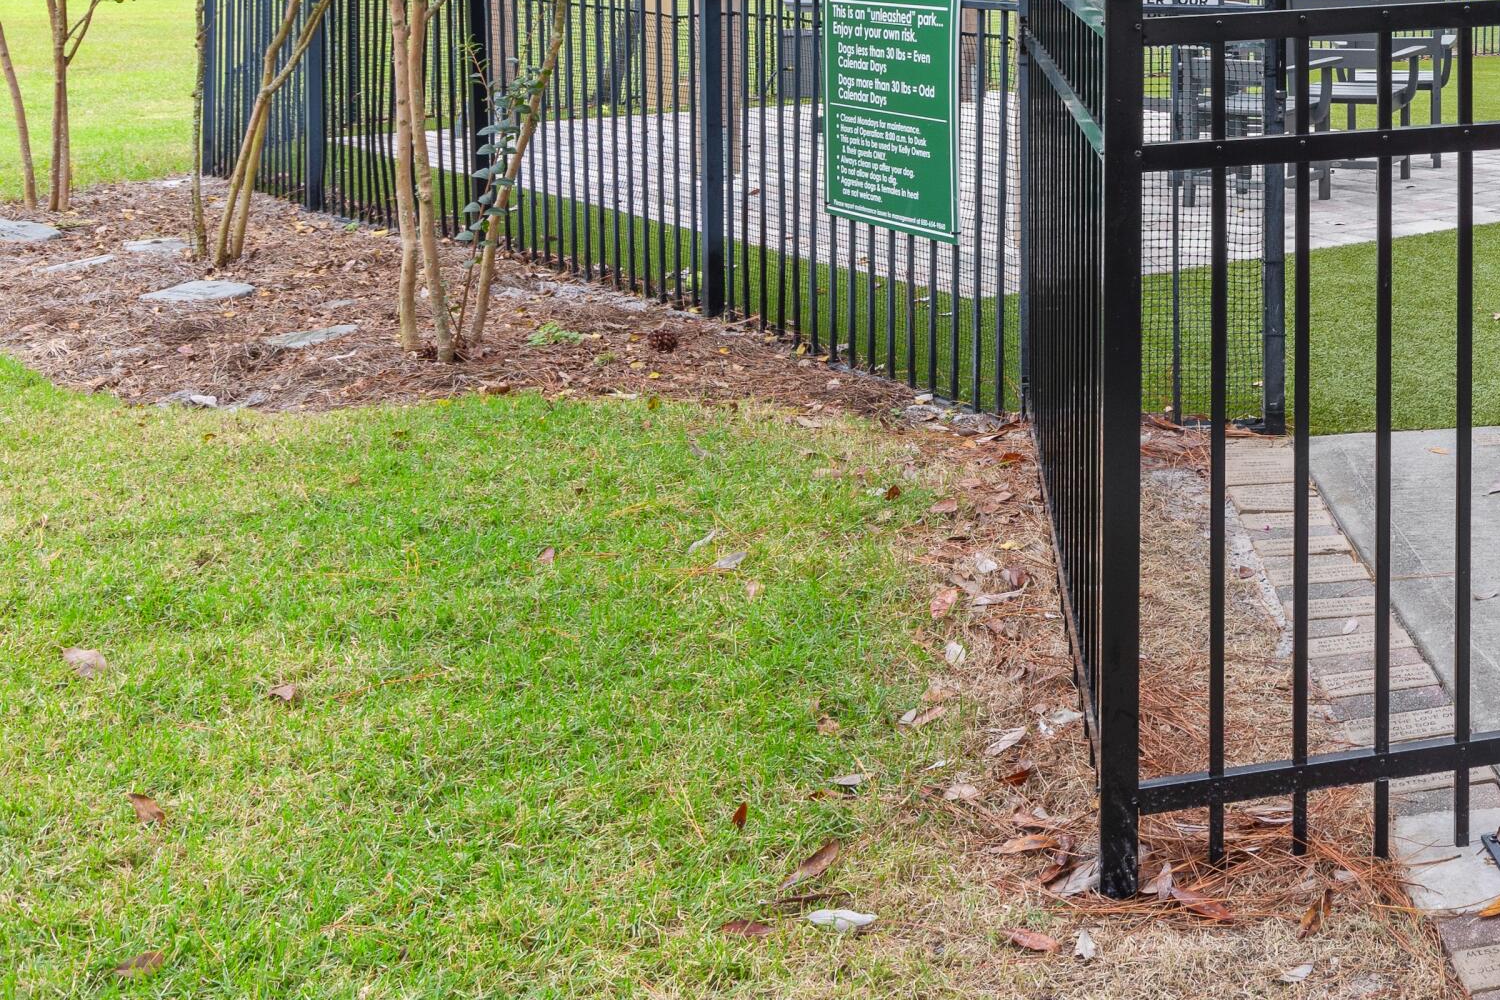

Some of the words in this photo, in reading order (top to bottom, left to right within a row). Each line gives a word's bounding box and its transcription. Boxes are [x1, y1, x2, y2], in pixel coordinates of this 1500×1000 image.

[832, 4, 846, 18] This
[848, 6, 854, 19] is
[856, 10, 865, 20] an
[918, 12, 944, 28] park...
[833, 22, 853, 38] Enjoy
[855, 24, 862, 36] at
[864, 27, 880, 40] your
[883, 29, 900, 39] own
[902, 28, 917, 42] risk.
[838, 42, 854, 56] Dogs
[856, 44, 868, 56] less
[870, 45, 885, 58] than
[886, 48, 895, 59] 30
[896, 48, 906, 61] lbs
[913, 50, 930, 64] Even
[838, 56, 868, 71] Calendar
[870, 60, 887, 75] Days
[838, 73, 854, 88] Dogs
[856, 78, 873, 88] more
[874, 78, 890, 92] than
[891, 81, 900, 93] 30
[901, 81, 911, 95] lbs
[919, 84, 935, 98] Odd
[838, 88, 868, 103] Calendar
[870, 92, 887, 107] Days
[840, 113, 856, 124] Closed
[857, 115, 878, 129] Mondays
[840, 124, 853, 133] Hours
[854, 126, 859, 134] of
[908, 135, 913, 144] to
[914, 136, 926, 146] Dusk
[850, 136, 860, 145] park
[865, 138, 870, 146] to
[871, 140, 878, 148] be
[878, 142, 890, 150] used
[891, 144, 898, 154] by
[899, 145, 911, 156] Kelly
[911, 147, 930, 158] Owners
[840, 155, 857, 167] Always
[858, 158, 871, 168] clean
[872, 162, 878, 170] up
[891, 166, 902, 176] your
[841, 165, 847, 174] Do
[848, 167, 856, 175] not
[856, 168, 869, 177] allow
[870, 170, 881, 182] dogs
[882, 174, 887, 182] to
[842, 187, 850, 196] are
[851, 189, 859, 197] not
[864, 180, 876, 192] dogs
[907, 189, 919, 200] heat
